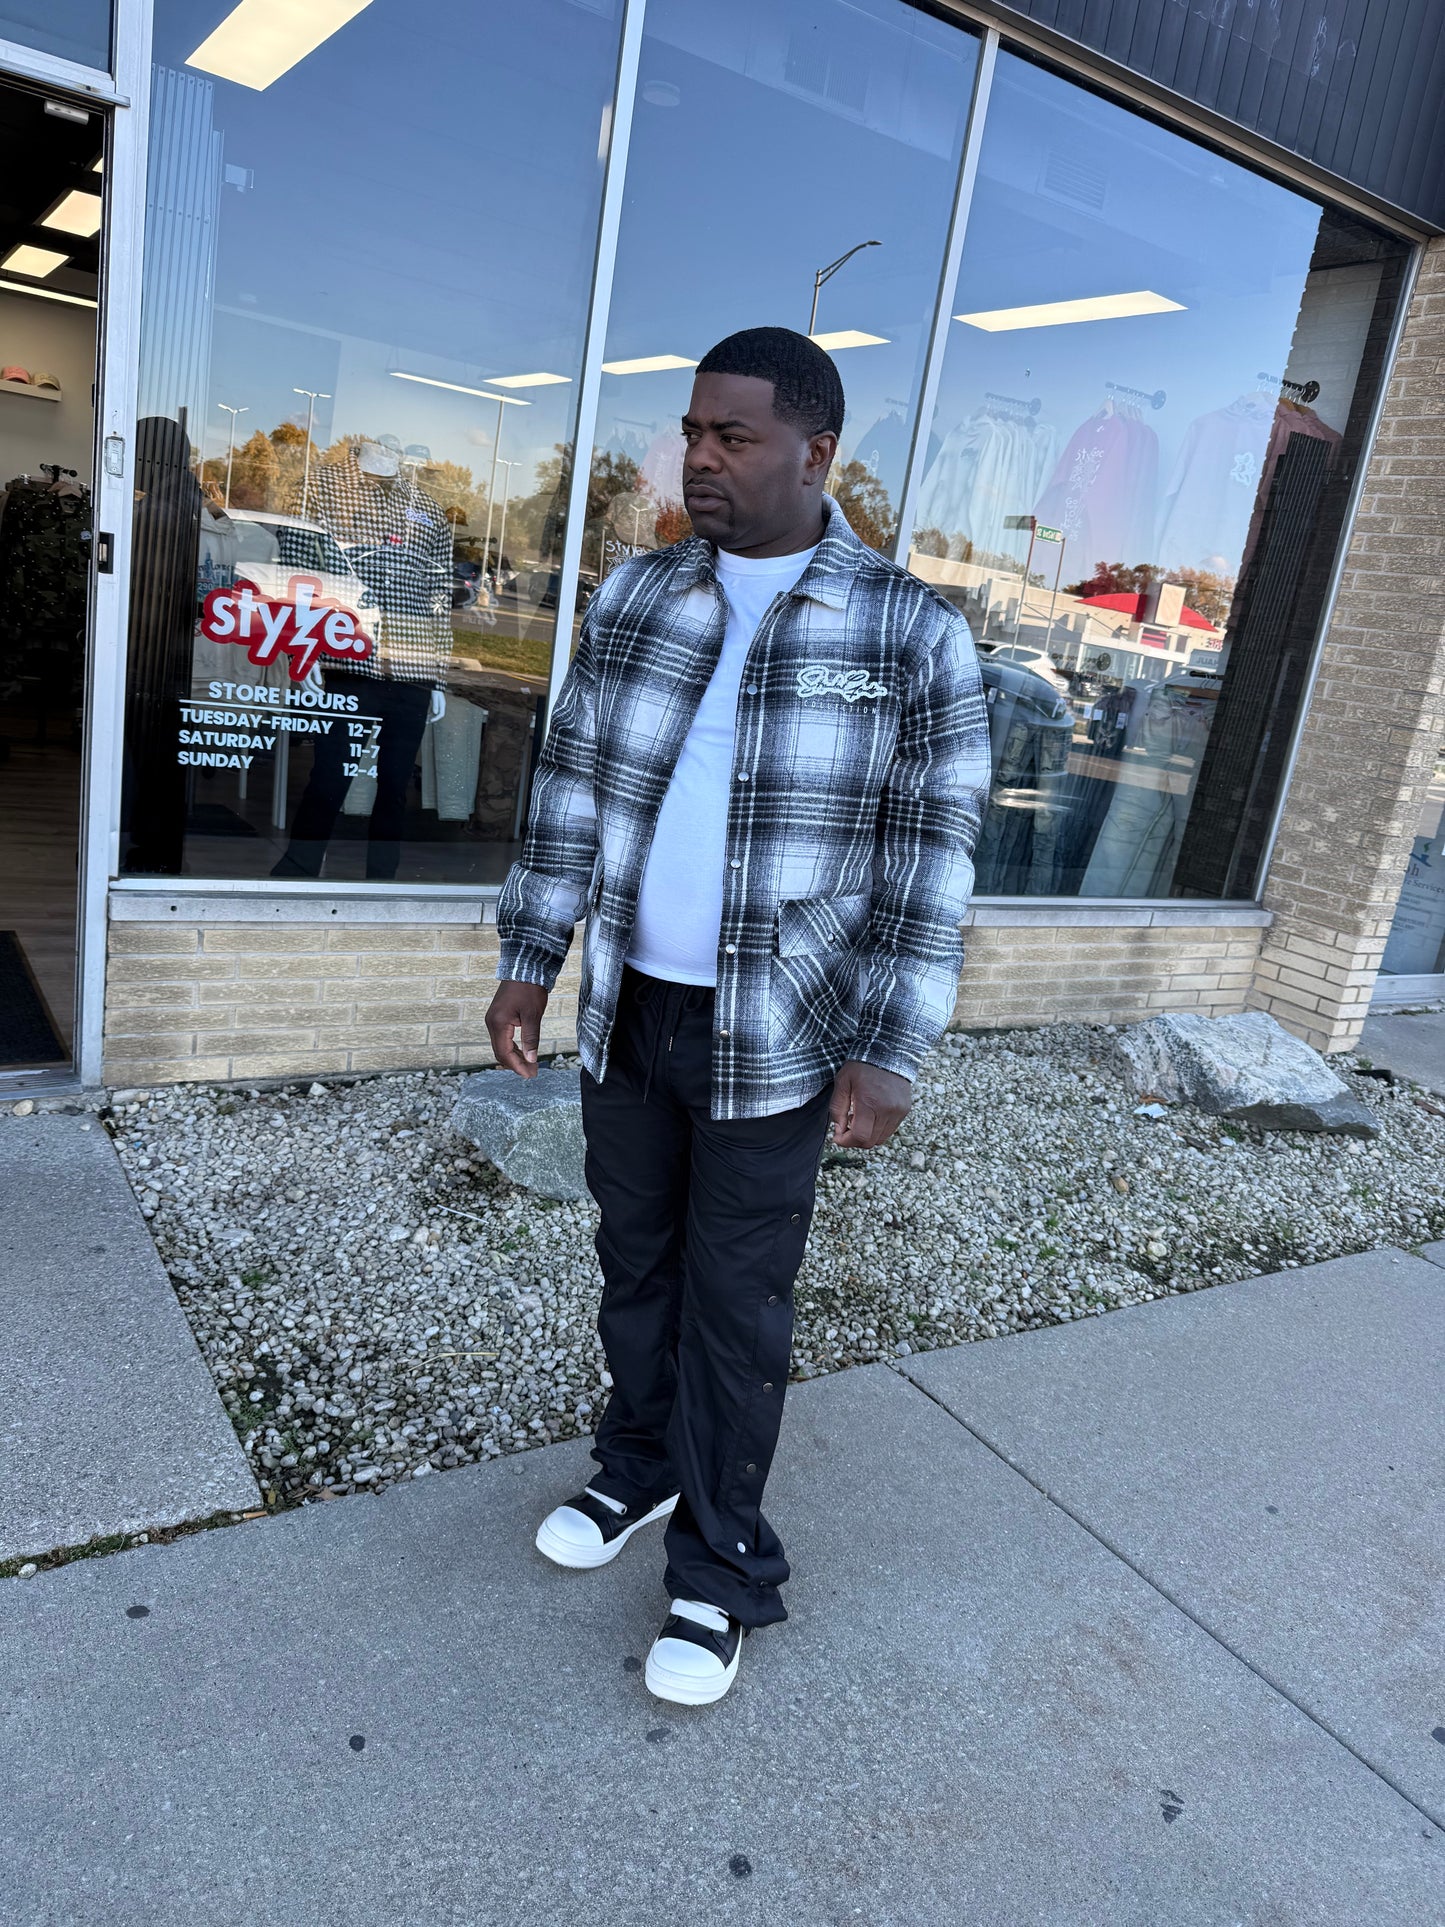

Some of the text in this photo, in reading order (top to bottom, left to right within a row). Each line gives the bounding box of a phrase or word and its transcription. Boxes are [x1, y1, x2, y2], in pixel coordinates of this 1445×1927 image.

[208, 681, 359, 713] STORE HOURS
[804, 701, 878, 714] COLLECTION
[179, 707, 382, 740] TUESDAY-FRIDAY 12-7
[178, 730, 380, 760] SATURDAY 11-7
[177, 751, 379, 779] SUNDAY 12-4
